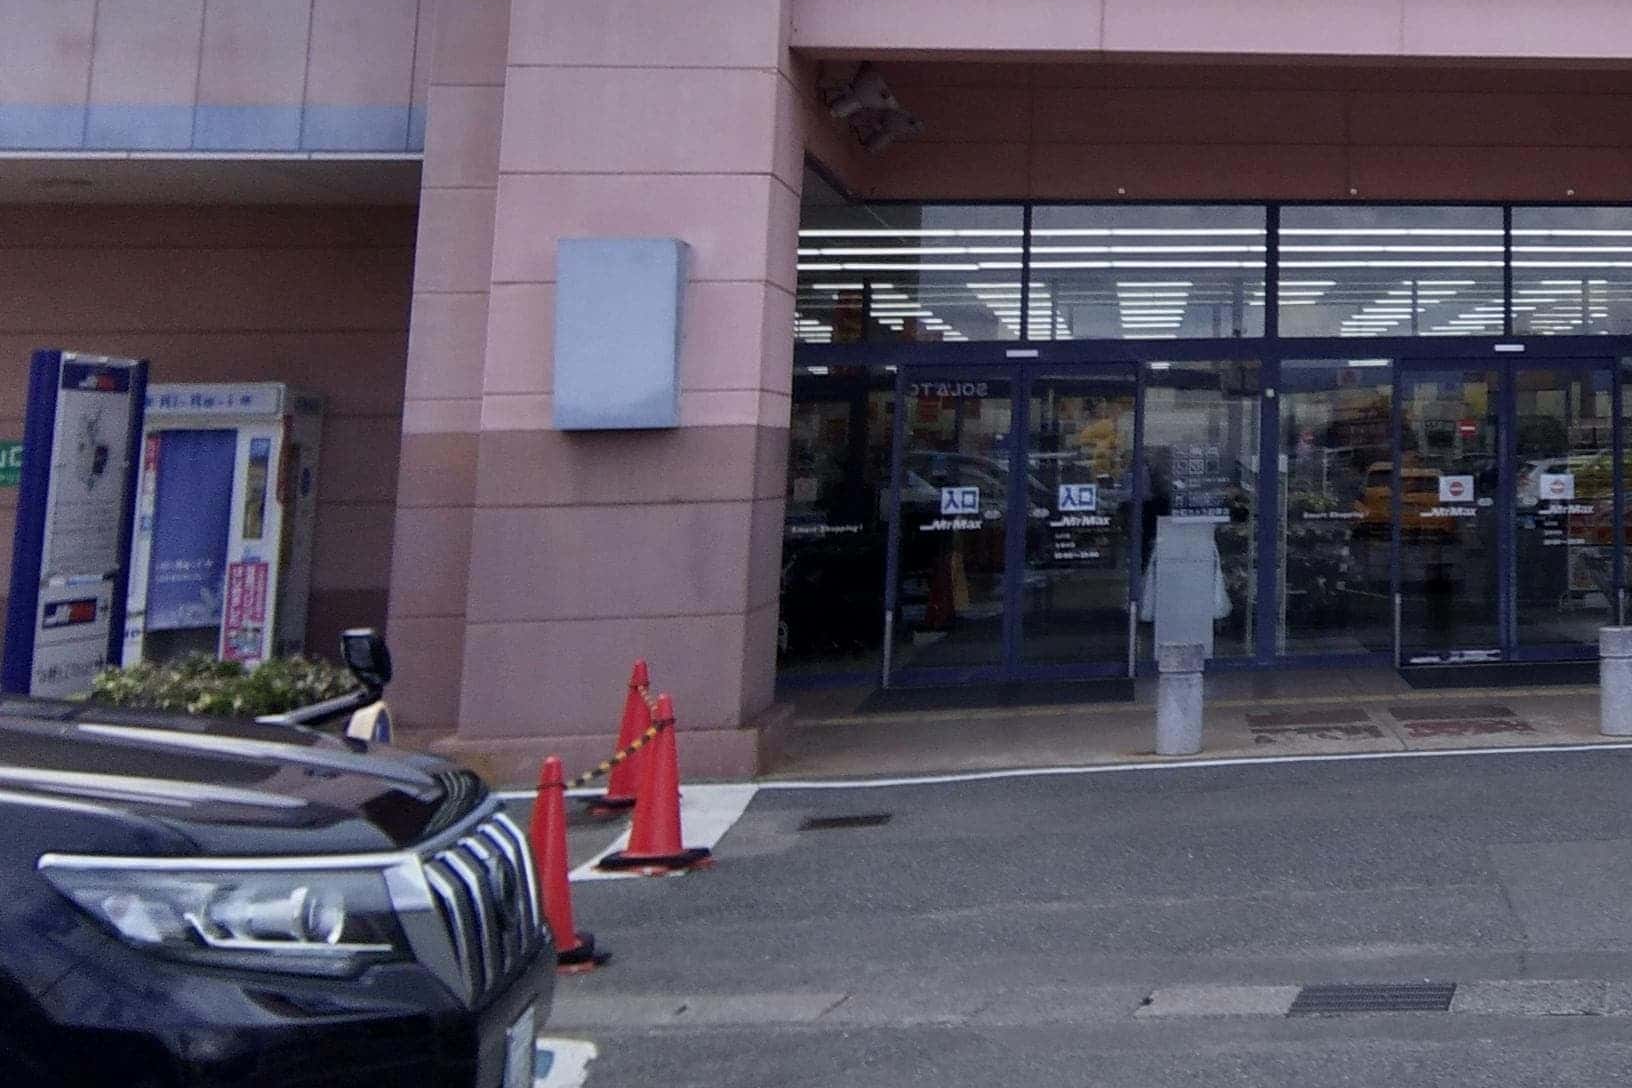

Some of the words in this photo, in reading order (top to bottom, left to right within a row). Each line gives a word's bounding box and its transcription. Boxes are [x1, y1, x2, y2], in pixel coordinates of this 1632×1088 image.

[943, 490, 977, 510] 入口
[1061, 487, 1094, 507] 入口
[920, 518, 983, 531] MrMax
